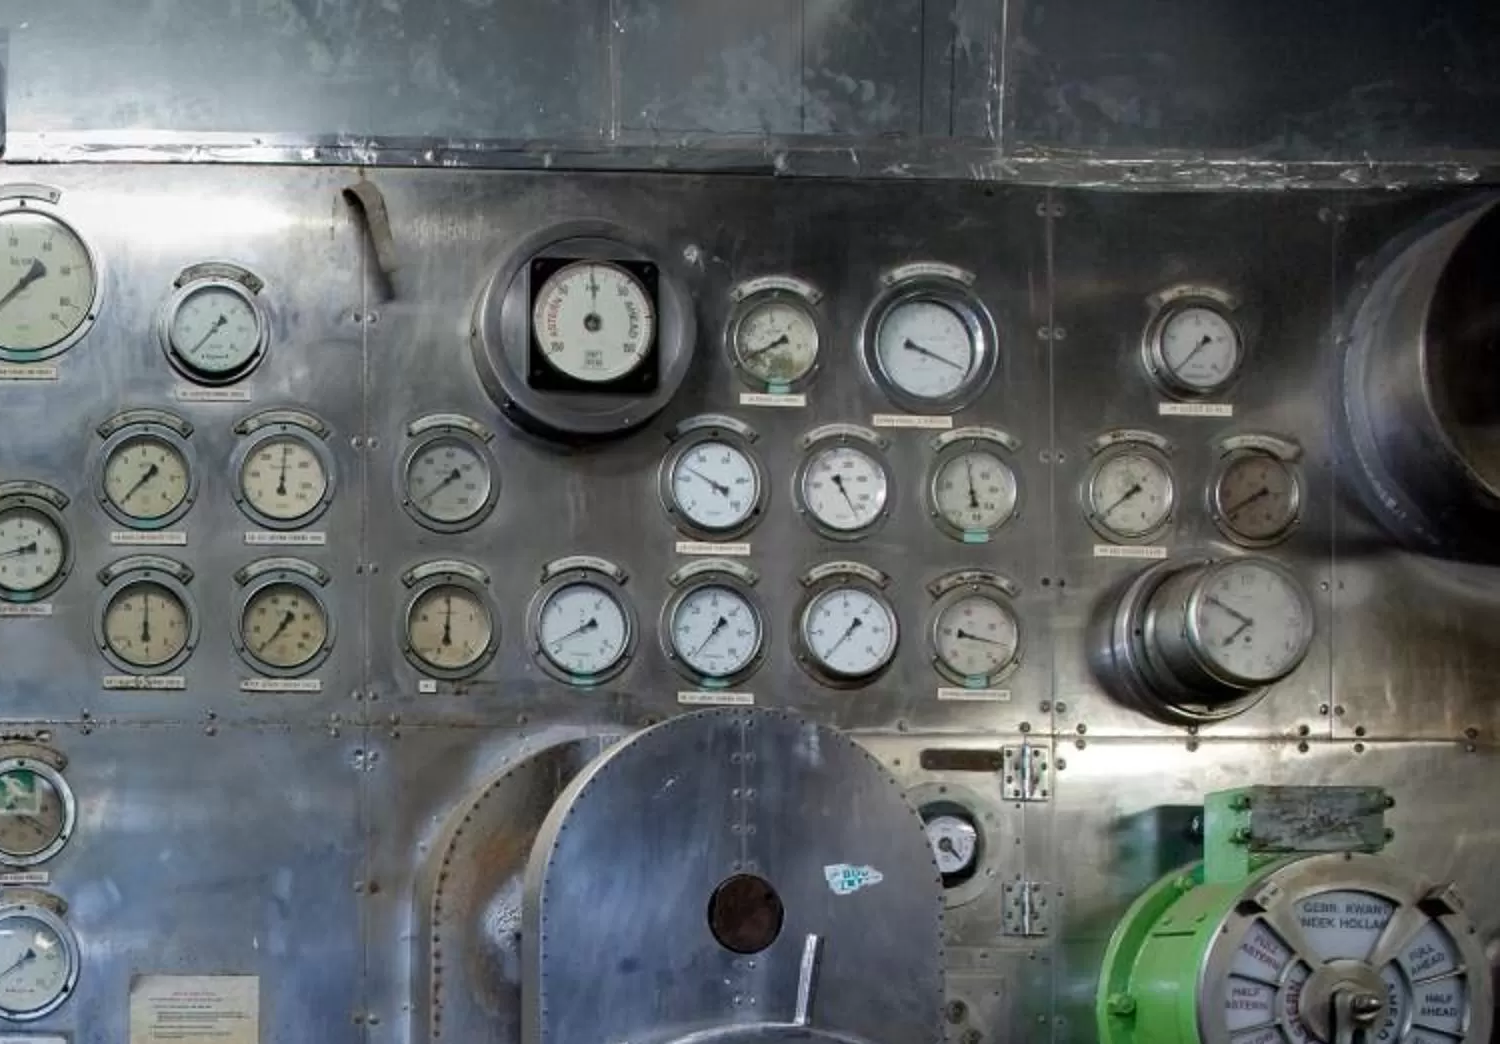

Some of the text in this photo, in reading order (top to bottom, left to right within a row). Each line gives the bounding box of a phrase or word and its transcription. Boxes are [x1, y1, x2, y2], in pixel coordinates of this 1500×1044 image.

[1408, 943, 1435, 960] FULL
[1411, 951, 1445, 977] AHEAD
[1232, 987, 1262, 997] HALF
[1424, 994, 1453, 1004] HALF
[1378, 982, 1399, 1041] AHEAD
[1420, 1006, 1458, 1018] AHEAD
